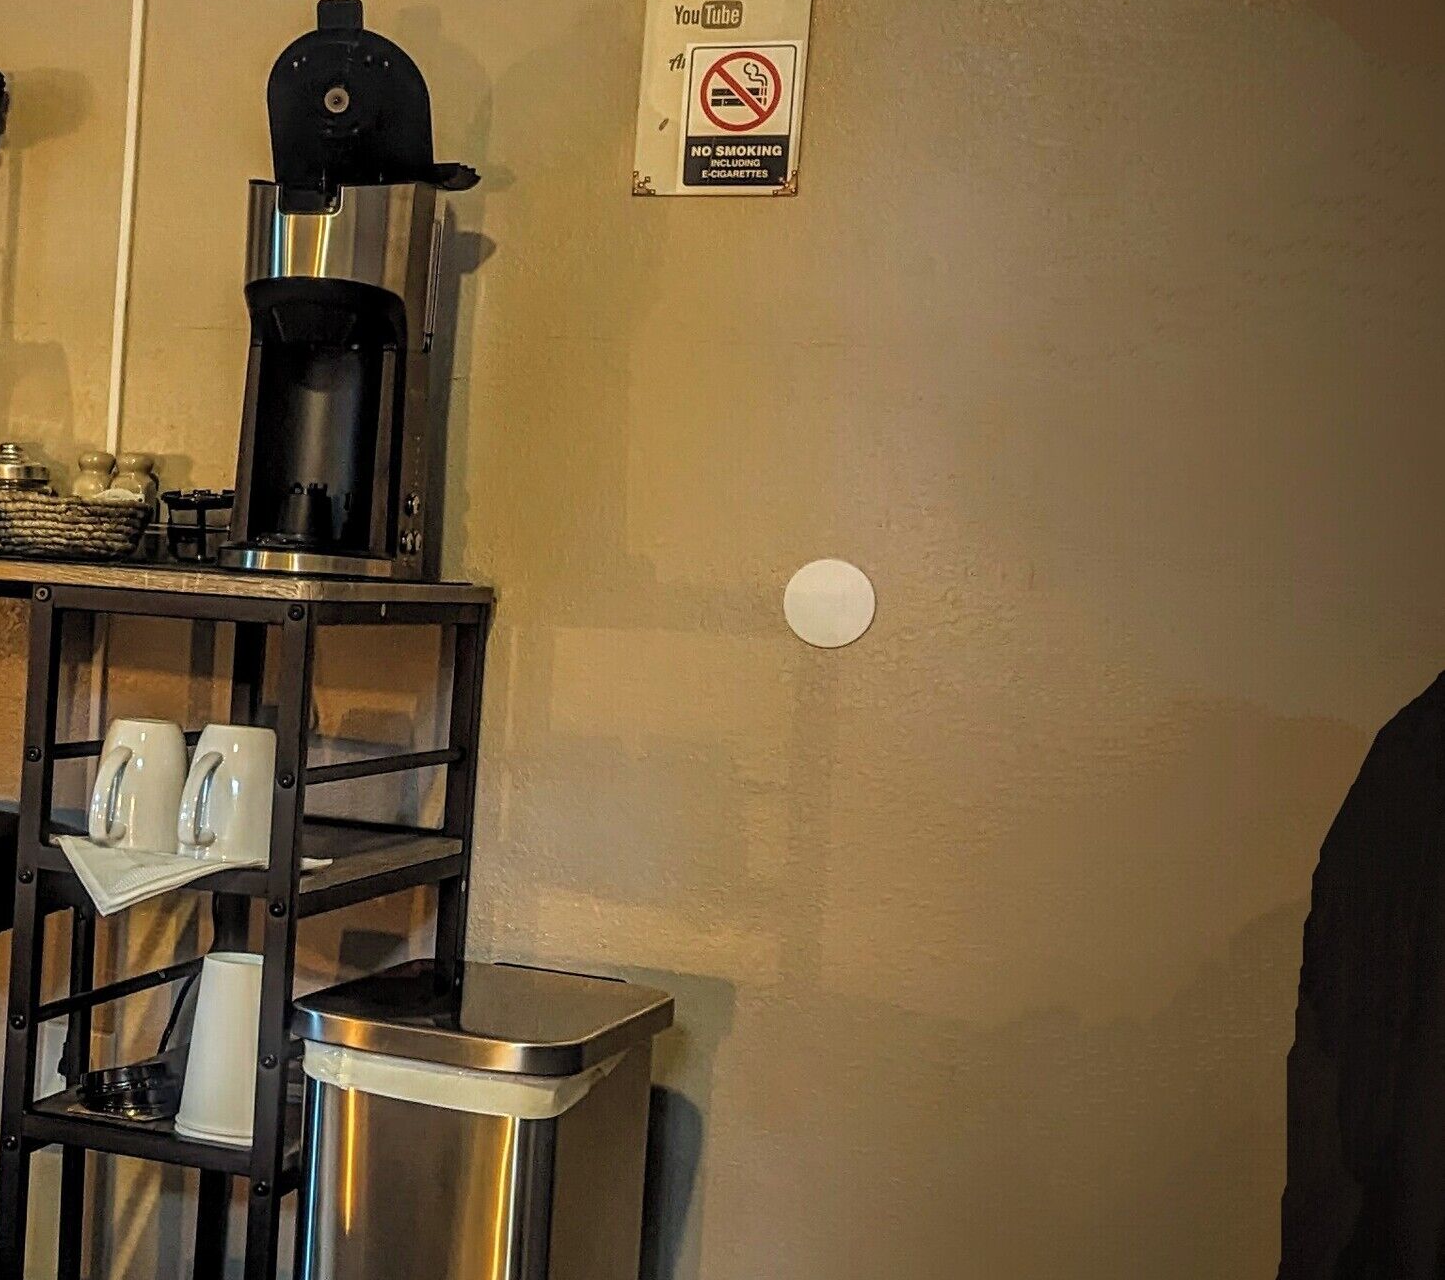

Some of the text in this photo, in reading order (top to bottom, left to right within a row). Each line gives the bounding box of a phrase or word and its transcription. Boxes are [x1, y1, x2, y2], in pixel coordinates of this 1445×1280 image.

[691, 145, 783, 157] NO SMOKING
[710, 158, 761, 168] INCLUDING
[701, 169, 769, 179] E-CIGARETTES
